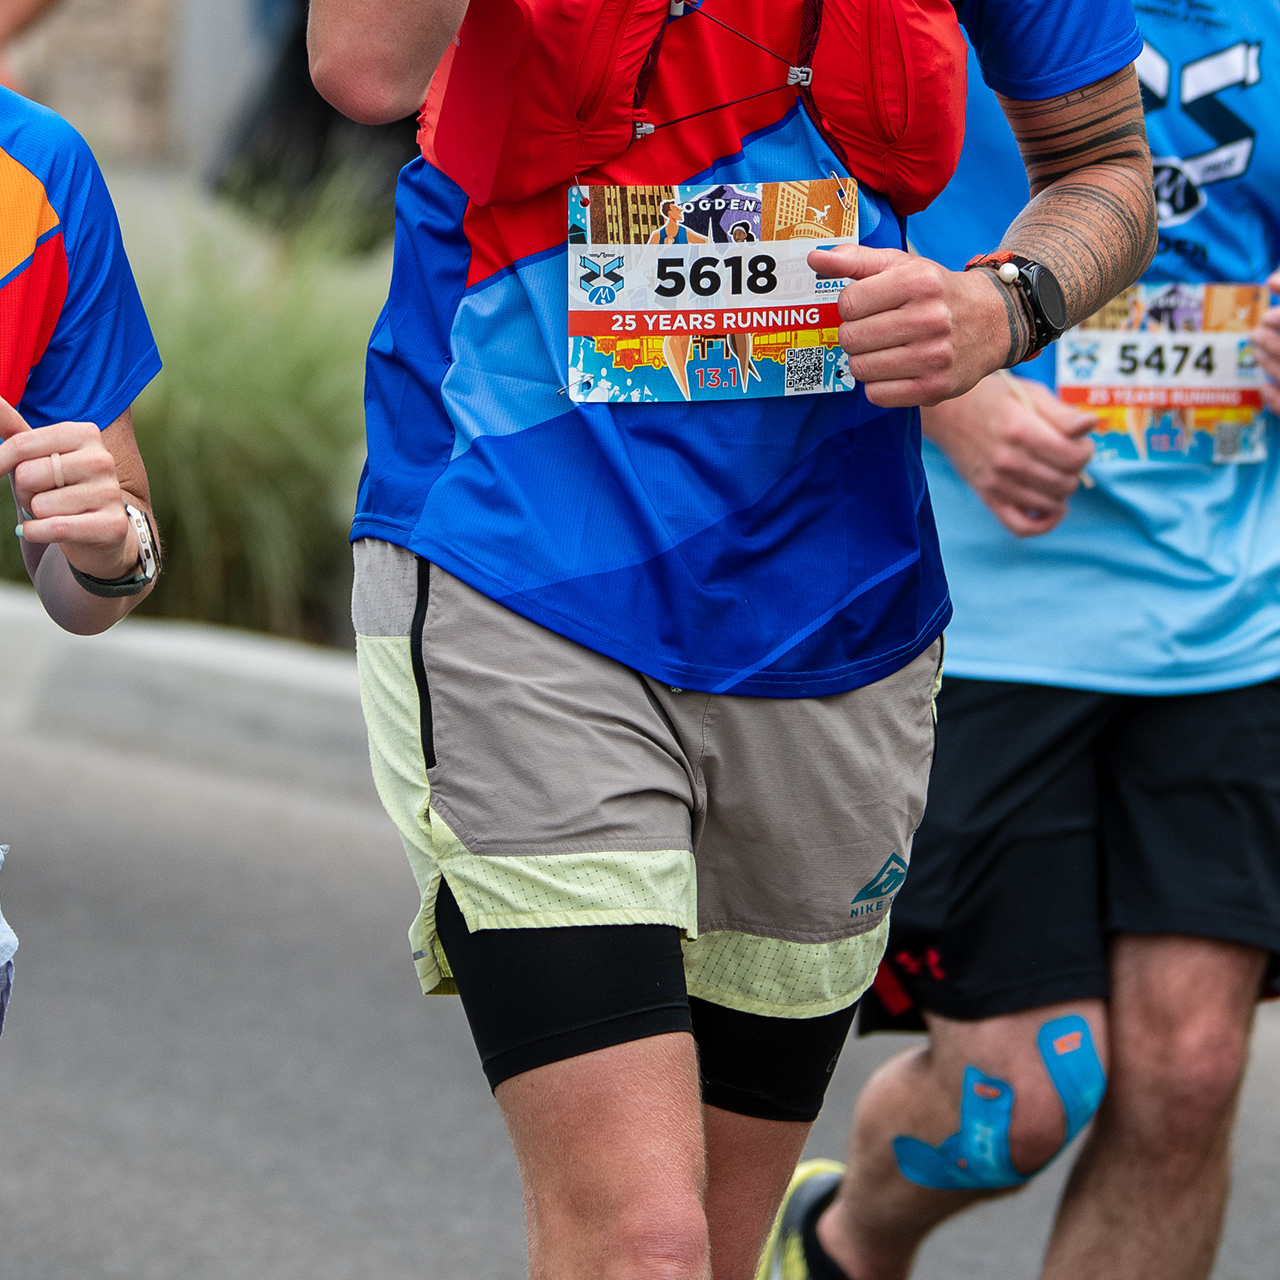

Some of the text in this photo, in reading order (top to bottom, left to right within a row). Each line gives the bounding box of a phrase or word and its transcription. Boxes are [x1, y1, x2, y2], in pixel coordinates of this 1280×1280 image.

[683, 198, 756, 213] OGDEN
[654, 254, 778, 298] 5618
[815, 280, 846, 289] GOAL
[611, 308, 820, 332] 25 YEARS RUNNING
[1119, 344, 1215, 376] 5474
[695, 368, 738, 388] 13.1
[850, 901, 883, 918] NIKE
